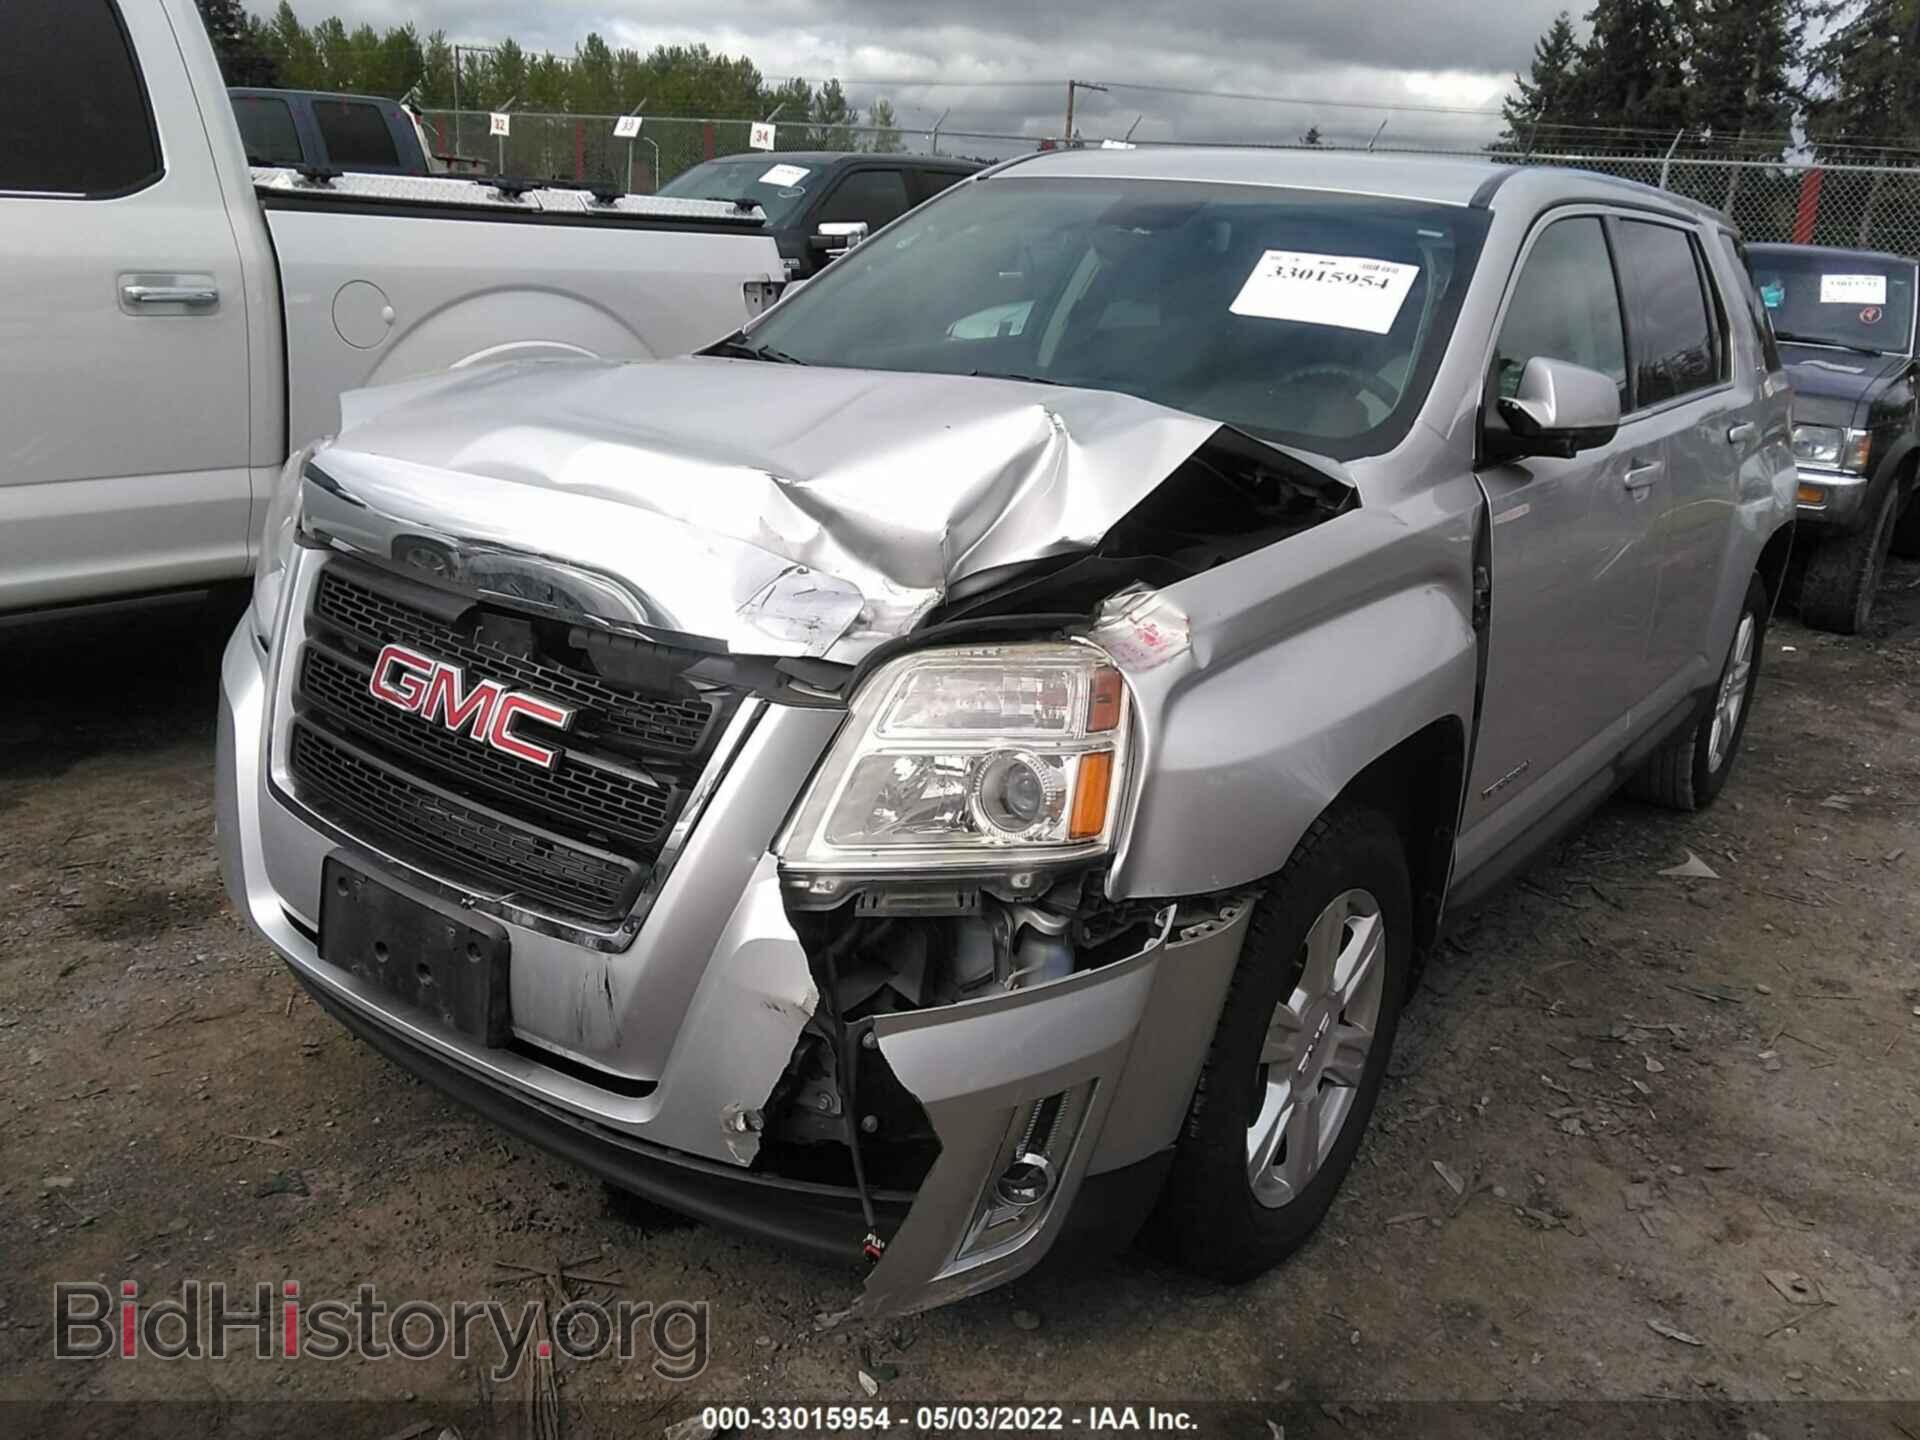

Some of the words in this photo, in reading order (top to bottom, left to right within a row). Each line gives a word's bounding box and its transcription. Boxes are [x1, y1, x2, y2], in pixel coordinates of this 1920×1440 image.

[754, 128, 769, 145] 34
[1266, 265, 1390, 289] 33015954
[369, 643, 575, 768] GMC
